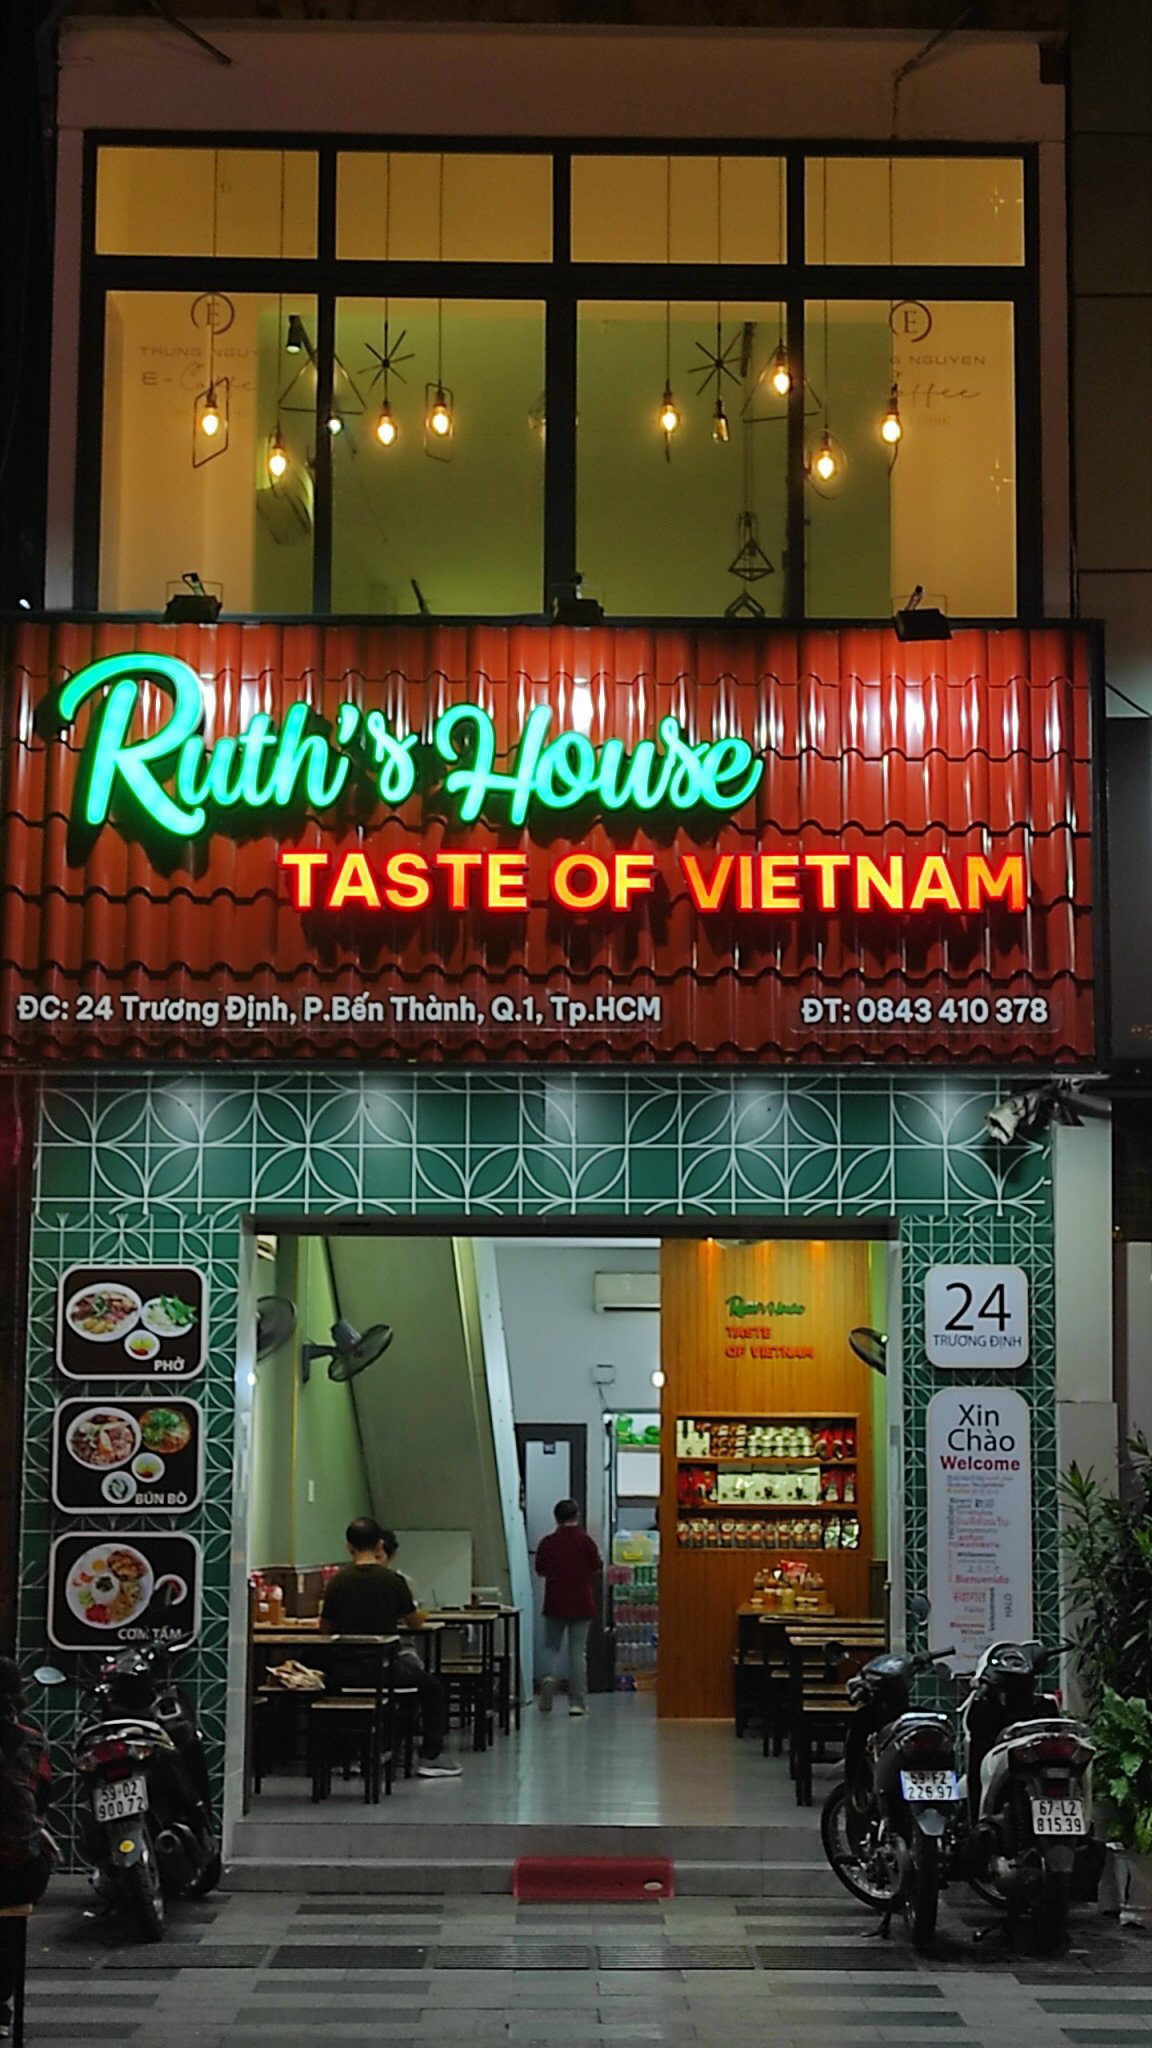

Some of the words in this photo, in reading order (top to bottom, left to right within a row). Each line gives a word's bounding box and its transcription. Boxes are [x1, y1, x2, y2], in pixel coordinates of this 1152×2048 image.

[903, 310, 918, 333] E
[909, 355, 986, 365] NGUYEN
[59, 652, 418, 837] Ruth's
[435, 704, 764, 827] House
[281, 850, 530, 912] TASTE
[552, 852, 656, 913] OF
[681, 852, 1027, 914] VIETNAM
[17, 995, 69, 1021] ĐC:
[76, 995, 114, 1021] 24
[120, 995, 220, 1027] Trương
[225, 995, 297, 1028] Định,
[304, 992, 384, 1022] P.Bến
[390, 996, 485, 1026] Thành,
[491, 996, 544, 1025] Q.1,
[550, 996, 661, 1027] Tp.HCM
[801, 998, 851, 1024] ĐT:
[857, 998, 932, 1024] 0843
[938, 998, 989, 1024] 410
[995, 998, 1048, 1024] 378
[944, 1282, 1012, 1332] 24
[725, 1326, 770, 1340] TASTE
[932, 1334, 987, 1347] TRƯƠNG
[725, 1346, 745, 1359] OF
[749, 1346, 814, 1360] VIETNAM
[153, 1357, 186, 1373] PHỞ
[958, 1404, 999, 1427] Xin
[947, 1429, 1015, 1452] Chào
[940, 1456, 1020, 1471] Welcome
[1039, 1800, 1077, 1816] 67-L2
